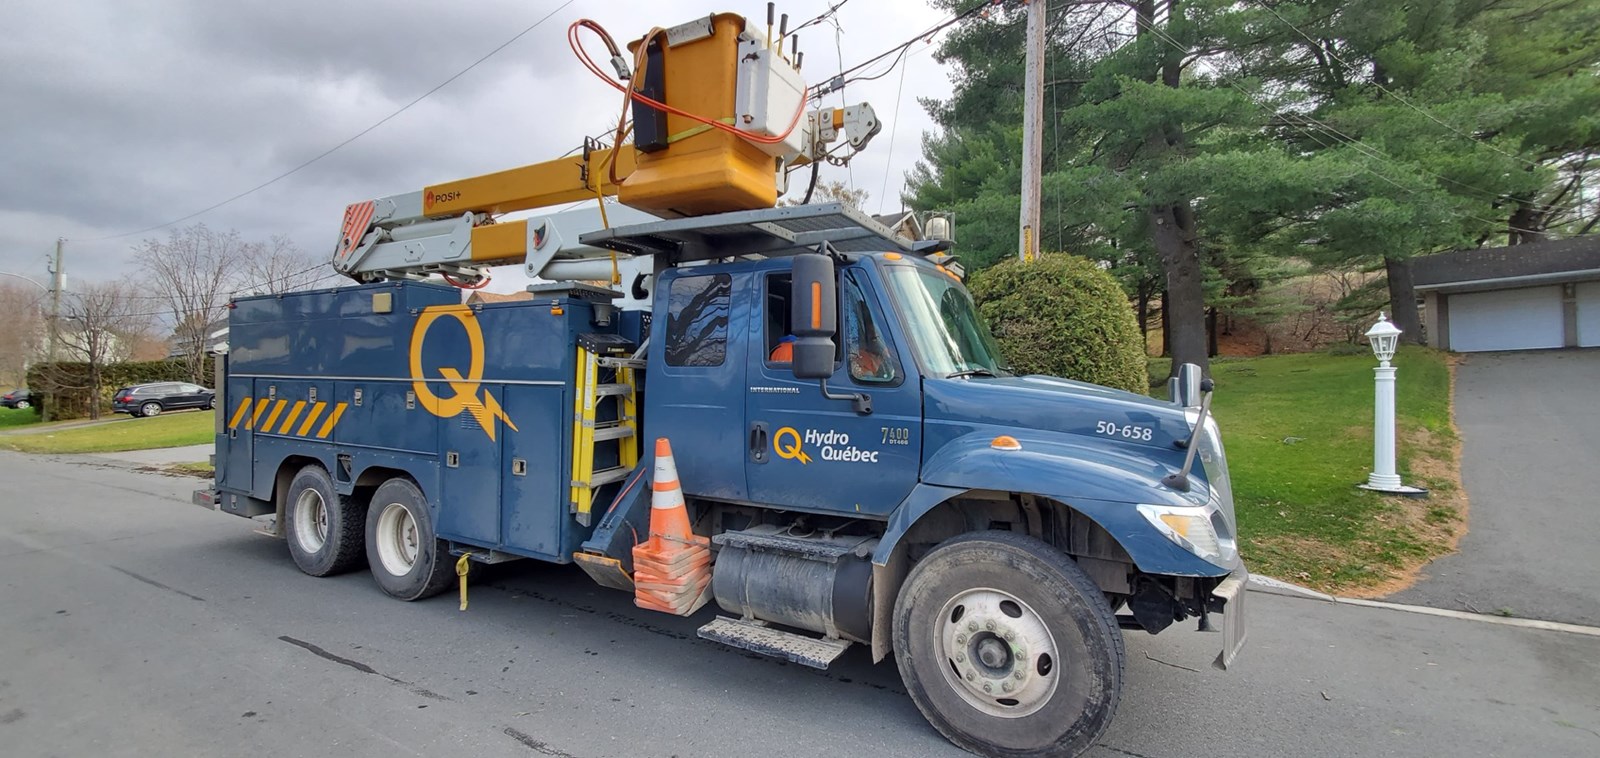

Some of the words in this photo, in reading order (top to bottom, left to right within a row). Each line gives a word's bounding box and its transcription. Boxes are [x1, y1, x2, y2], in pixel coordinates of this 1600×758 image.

[750, 386, 800, 394] INTERNATIONAL
[804, 428, 849, 447] Hydro
[881, 427, 909, 444] 7400
[1096, 420, 1153, 441] 50-658
[820, 446, 879, 463] Québec
